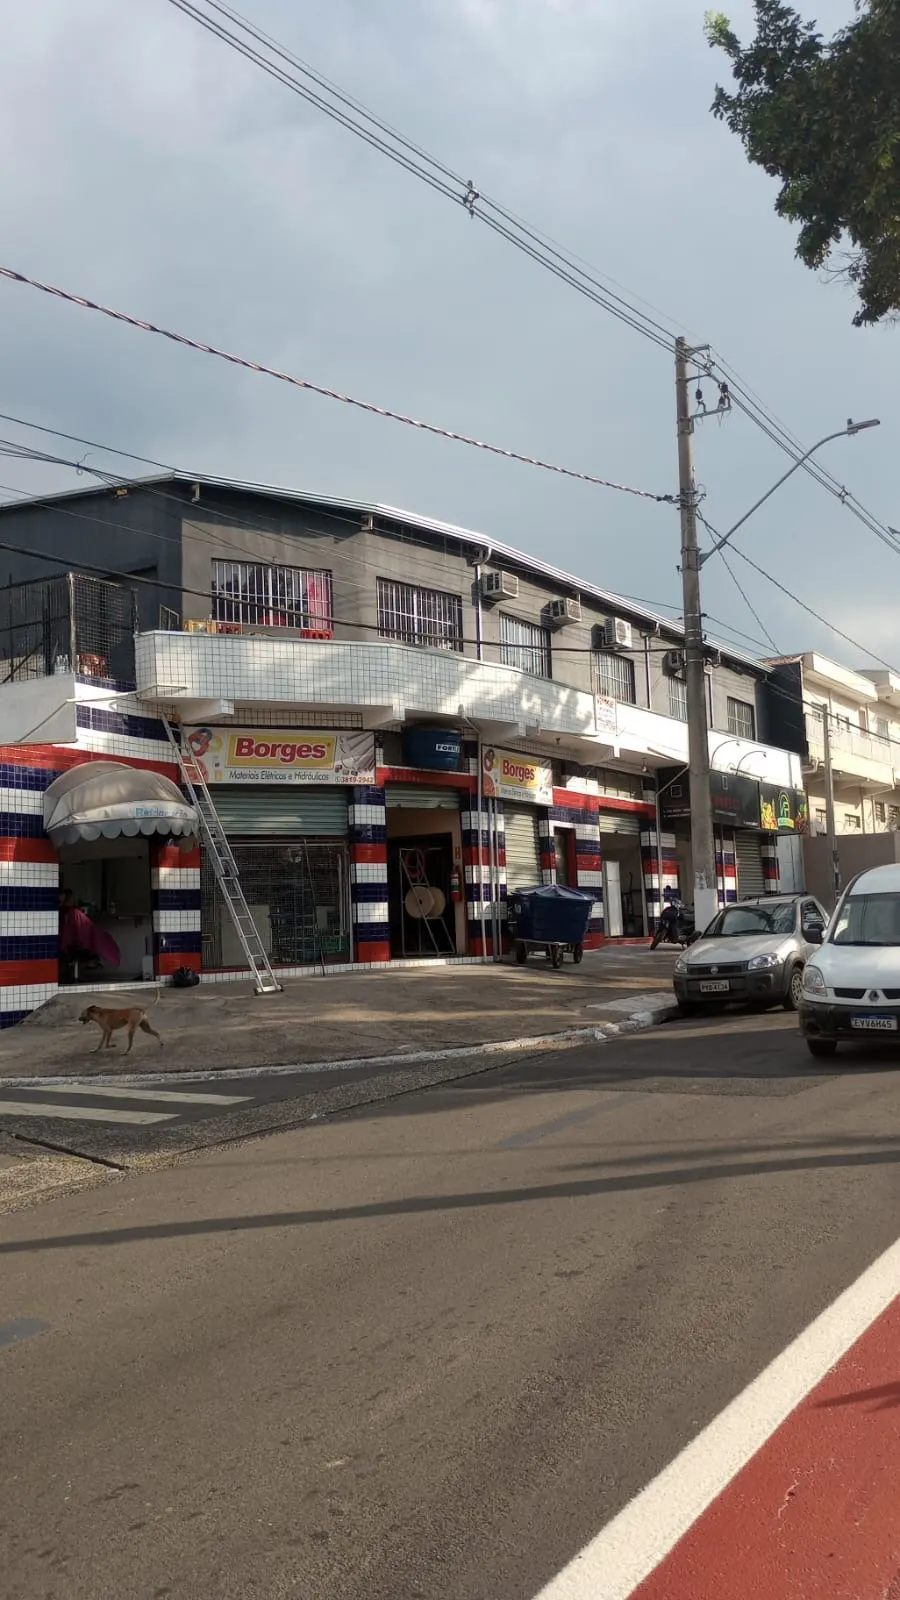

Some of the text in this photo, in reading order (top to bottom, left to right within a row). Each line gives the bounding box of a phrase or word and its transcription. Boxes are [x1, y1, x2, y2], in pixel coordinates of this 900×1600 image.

[235, 737, 326, 763] Borges
[229, 770, 259, 781] Materiais
[502, 760, 536, 782] Borges
